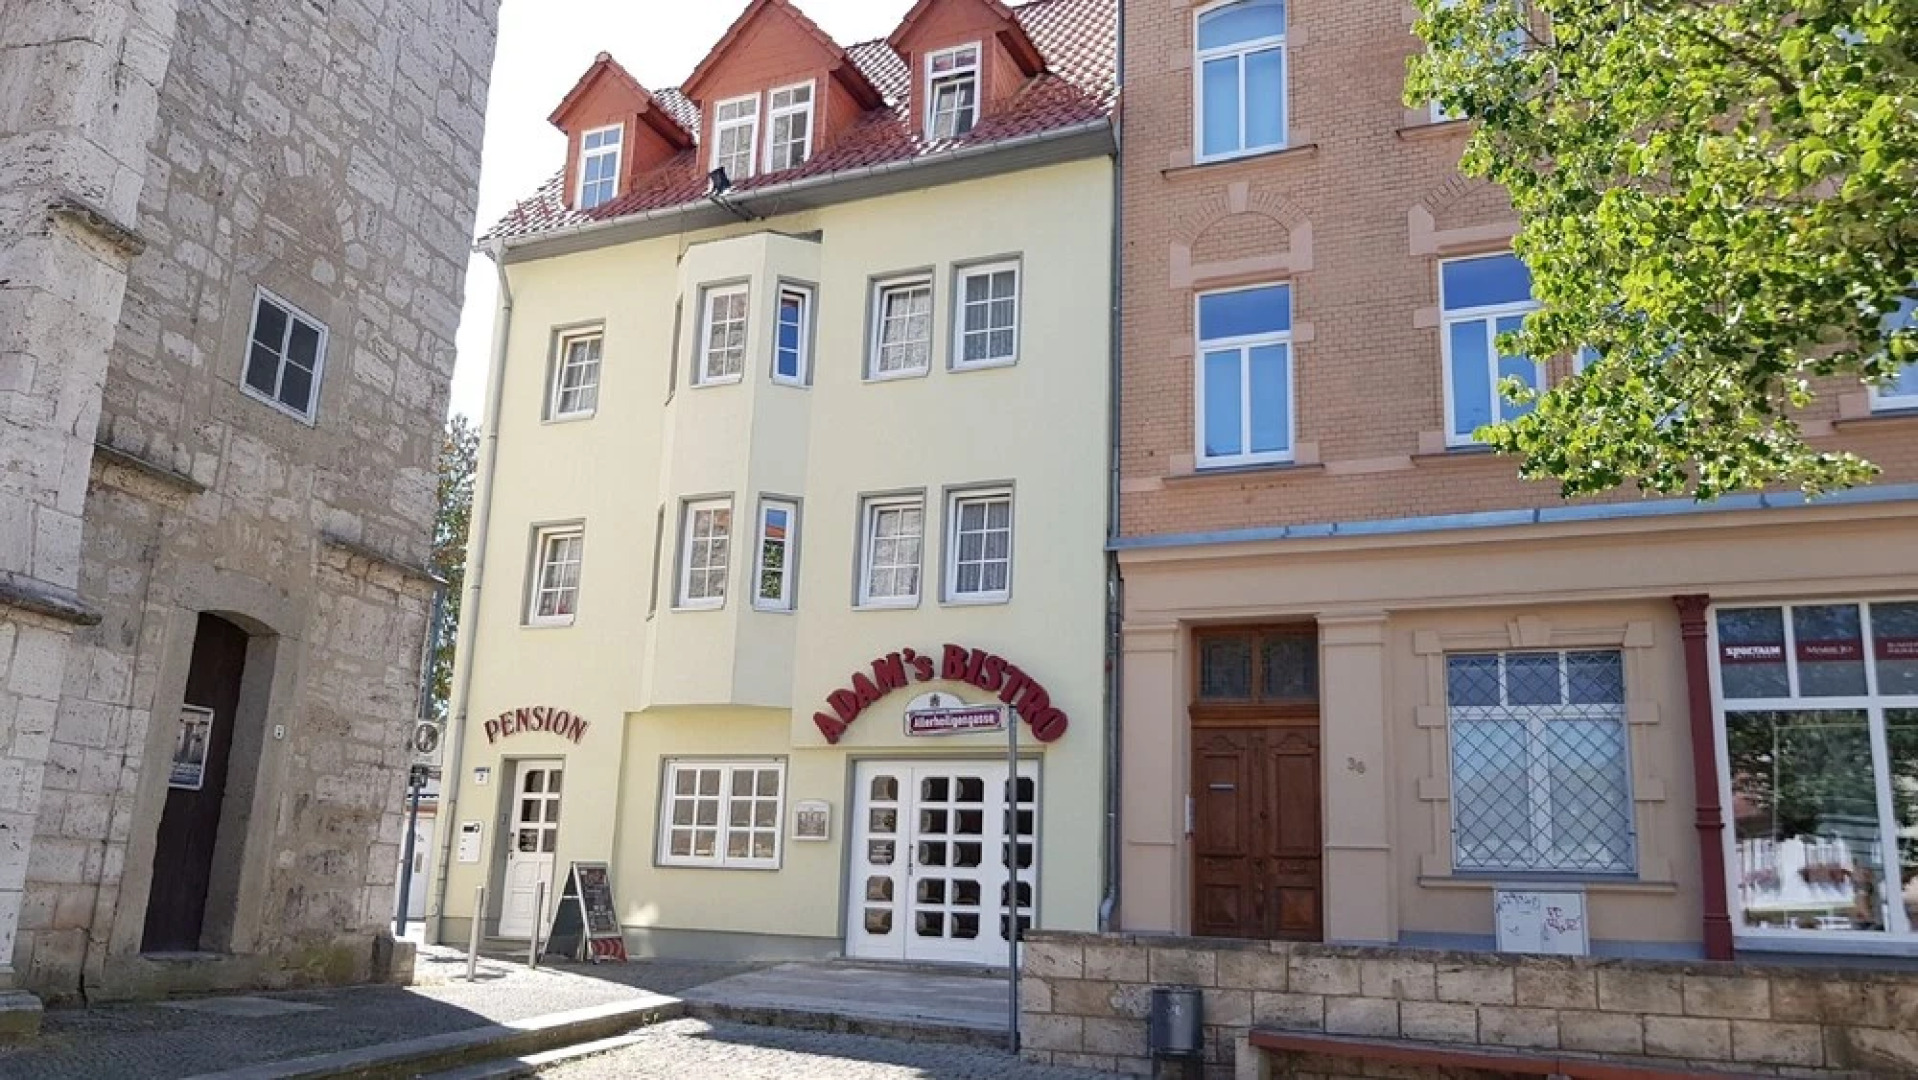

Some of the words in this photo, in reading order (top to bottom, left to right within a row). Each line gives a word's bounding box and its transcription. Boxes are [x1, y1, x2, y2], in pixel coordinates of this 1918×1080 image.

[484, 705, 589, 744] PENSION
[813, 647, 935, 744] ADAM's
[942, 643, 1068, 742] BISTRO
